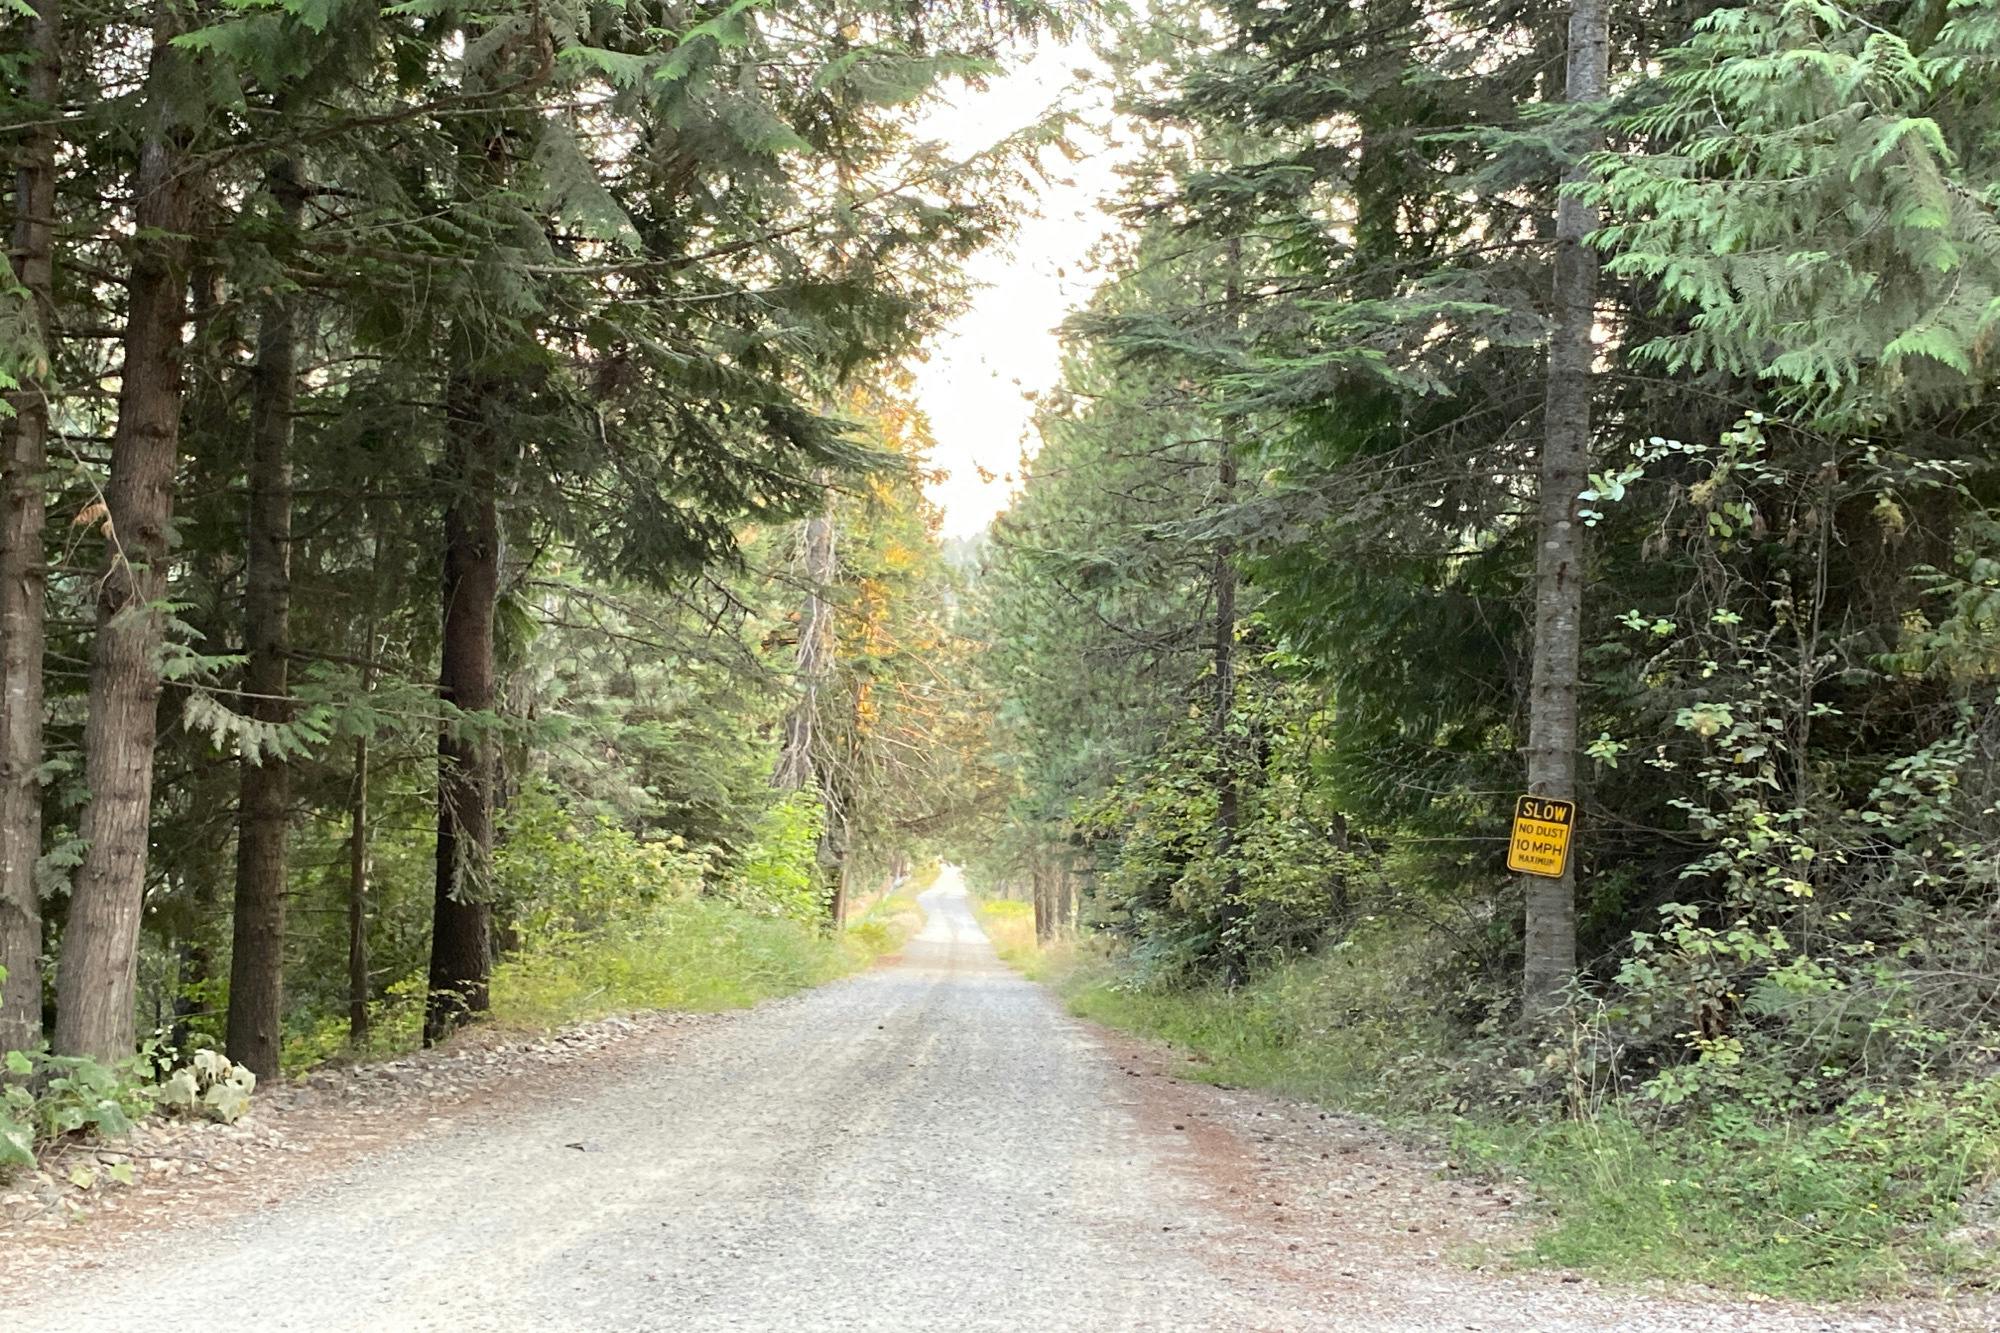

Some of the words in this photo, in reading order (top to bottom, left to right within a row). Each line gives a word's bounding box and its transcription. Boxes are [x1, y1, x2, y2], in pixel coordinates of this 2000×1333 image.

[1523, 801, 1567, 821] SLOW
[1519, 824, 1533, 834] NO
[1536, 826, 1565, 838] DUST
[1516, 839, 1529, 851] 10
[1532, 841, 1562, 856] MPH
[1519, 855, 1555, 866] MAXIMUM
